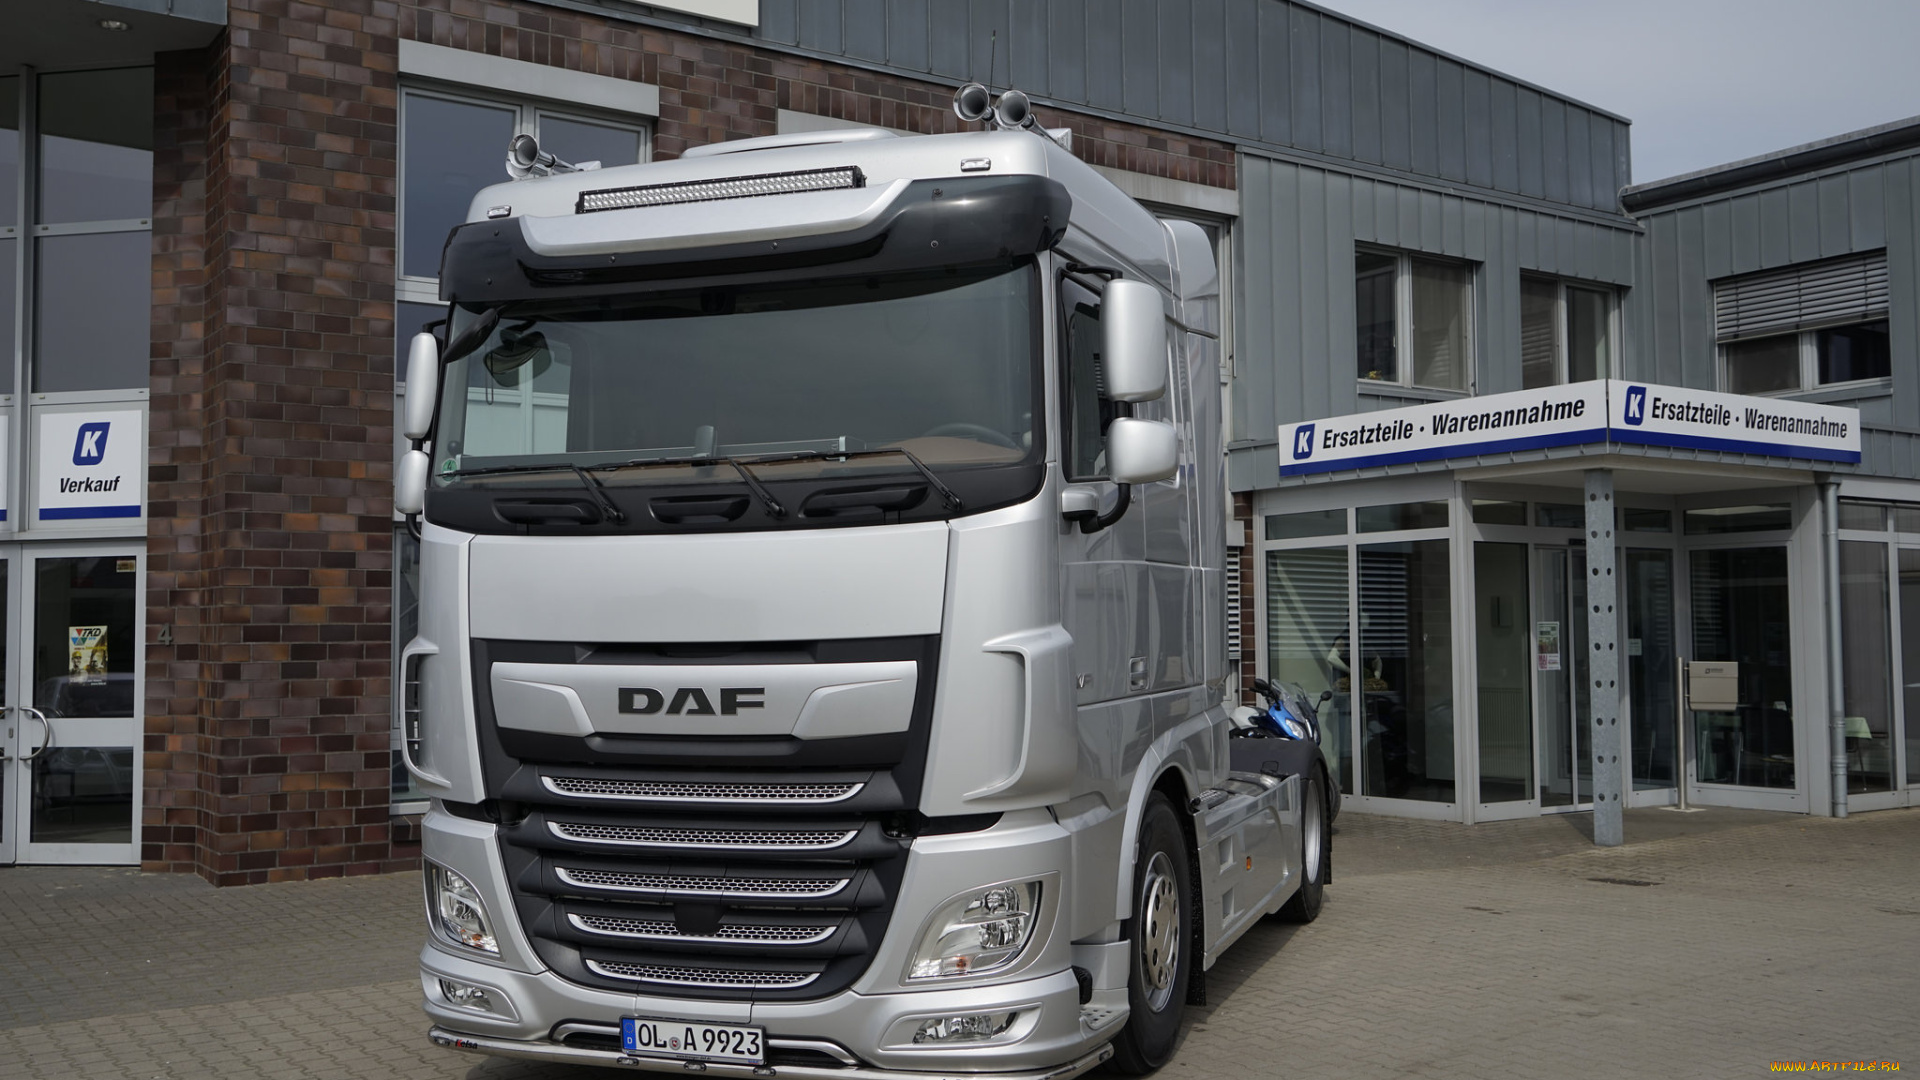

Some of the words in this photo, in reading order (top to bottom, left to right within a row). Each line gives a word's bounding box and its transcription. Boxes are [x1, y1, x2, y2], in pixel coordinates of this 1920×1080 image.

[1297, 430, 1311, 454] K
[1322, 419, 1414, 449] Ersatzteile
[1432, 399, 1585, 436] Warenannahme
[1628, 393, 1643, 419] K
[1651, 397, 1731, 426] Ersatzteile
[1745, 407, 1848, 438] Warenannahme
[80, 430, 103, 458] K
[60, 475, 121, 494] Verkauf
[82, 627, 102, 638] TKD
[157, 623, 174, 647] 4
[618, 687, 766, 716] DAF
[638, 1023, 668, 1048] OL
[683, 1027, 698, 1051] A
[702, 1028, 760, 1056] 9923
